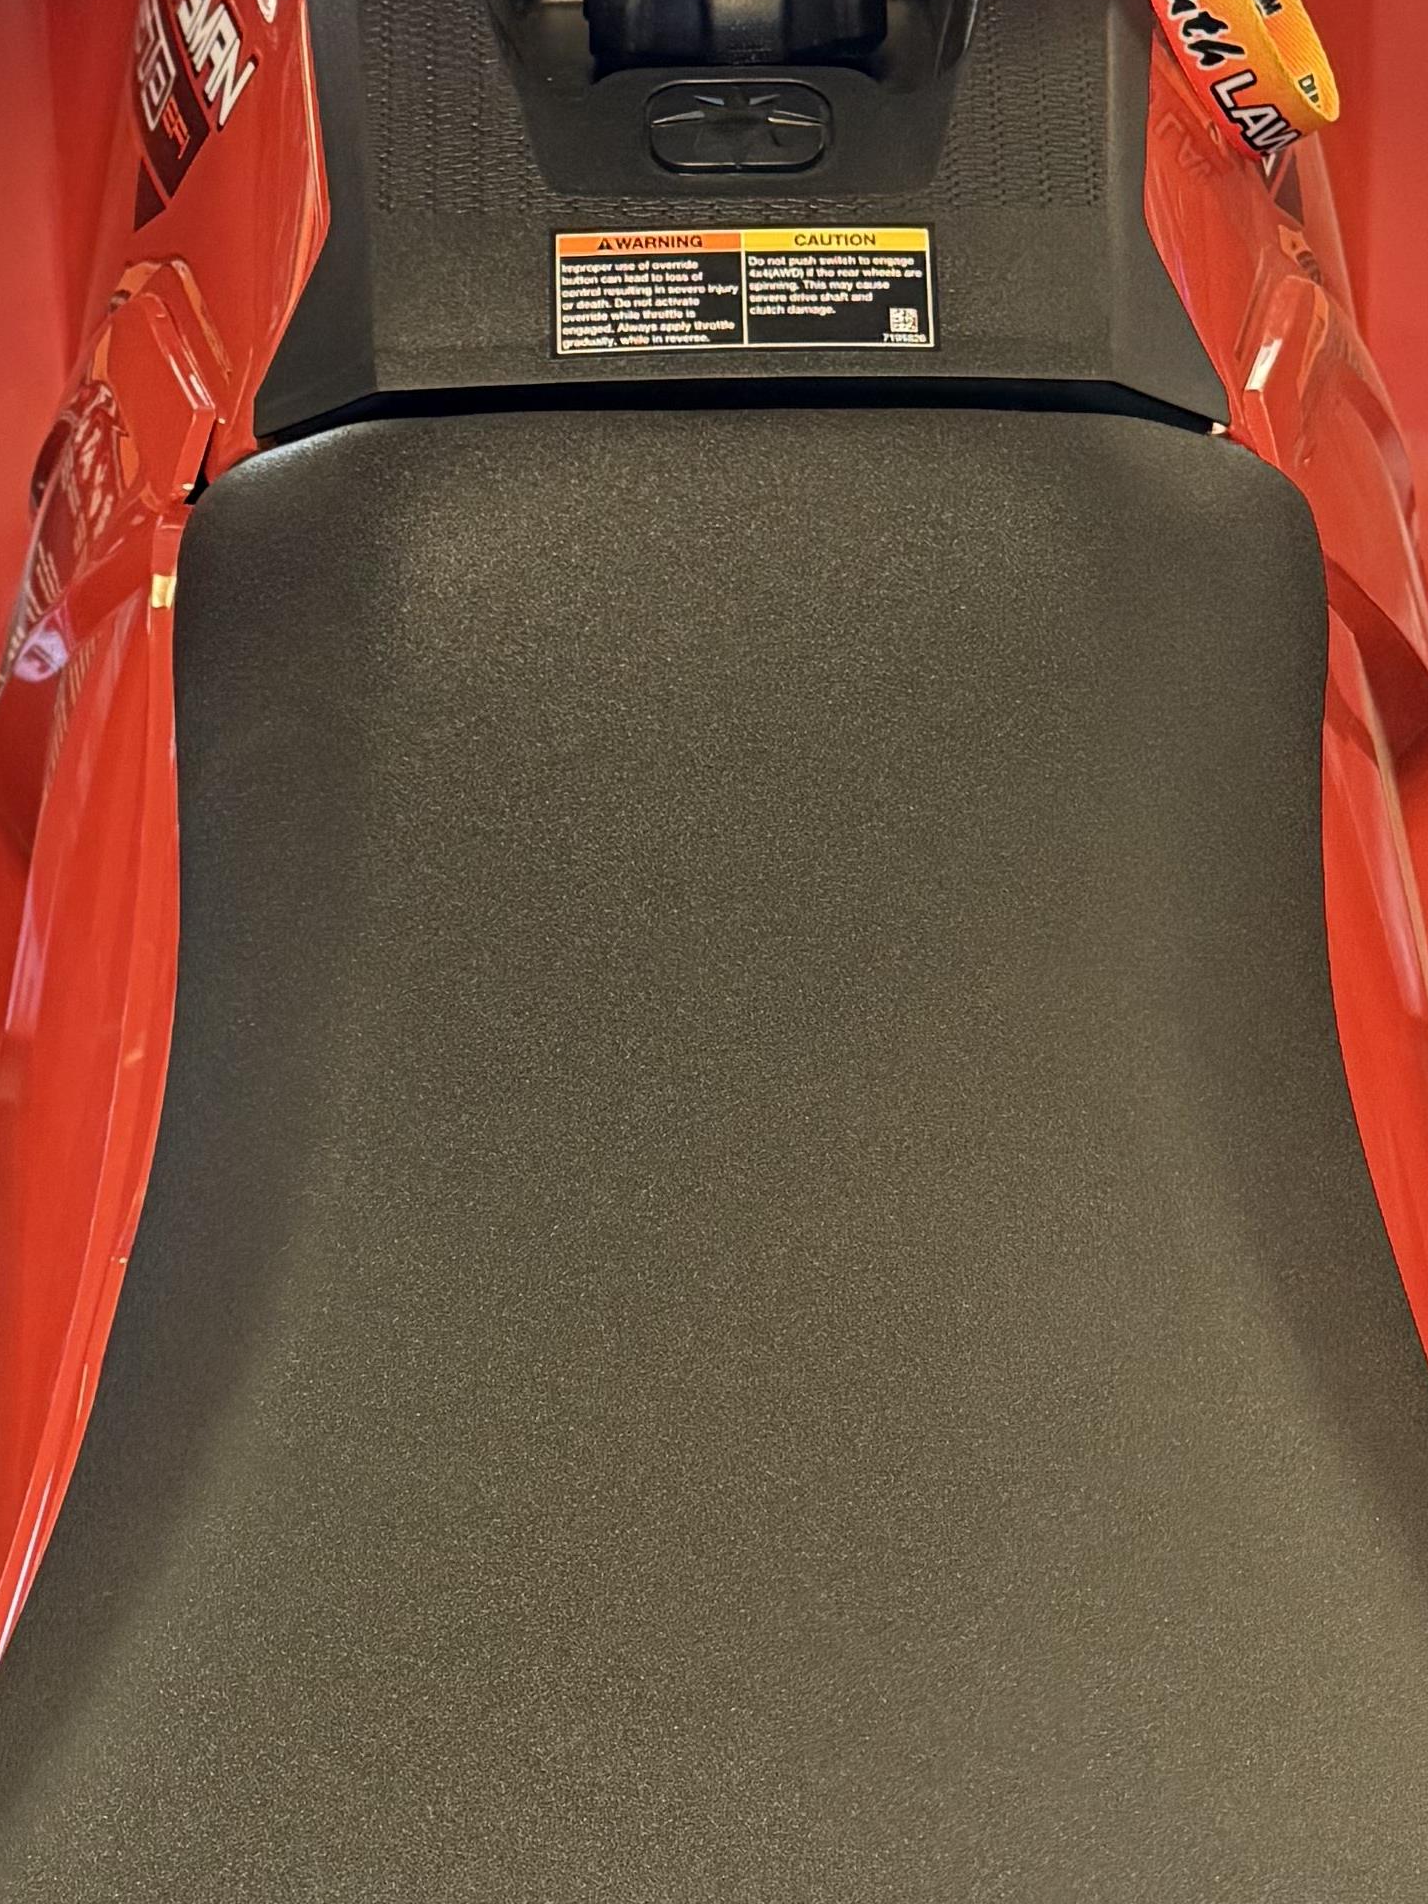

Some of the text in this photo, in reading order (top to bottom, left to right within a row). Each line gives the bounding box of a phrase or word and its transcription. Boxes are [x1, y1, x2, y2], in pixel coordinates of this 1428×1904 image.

[615, 235, 703, 250] WARNING
[794, 233, 876, 247] CAUTION
[562, 264, 611, 273] Improper
[638, 261, 649, 270] of
[652, 261, 698, 270] override
[748, 256, 914, 266] Do not push switch to engage
[562, 272, 702, 285] button can lead to loss of
[806, 268, 813, 276] if
[816, 268, 834, 276] the
[862, 268, 901, 277] wheels
[562, 288, 600, 297] control
[654, 285, 665, 293] in
[668, 285, 705, 294] severe
[708, 284, 738, 294] injury
[804, 279, 826, 289] This
[829, 281, 852, 290] may
[856, 281, 889, 289] cause
[749, 292, 873, 302] severe drive shaft and
[562, 297, 700, 310] or death. Do not activate
[749, 305, 836, 314] clutch damage.
[562, 309, 695, 322] override while throttle is
[562, 320, 735, 336] engaged. Always apply throttle
[620, 335, 649, 344] while
[652, 335, 662, 343] in
[665, 334, 710, 342] reverse.
